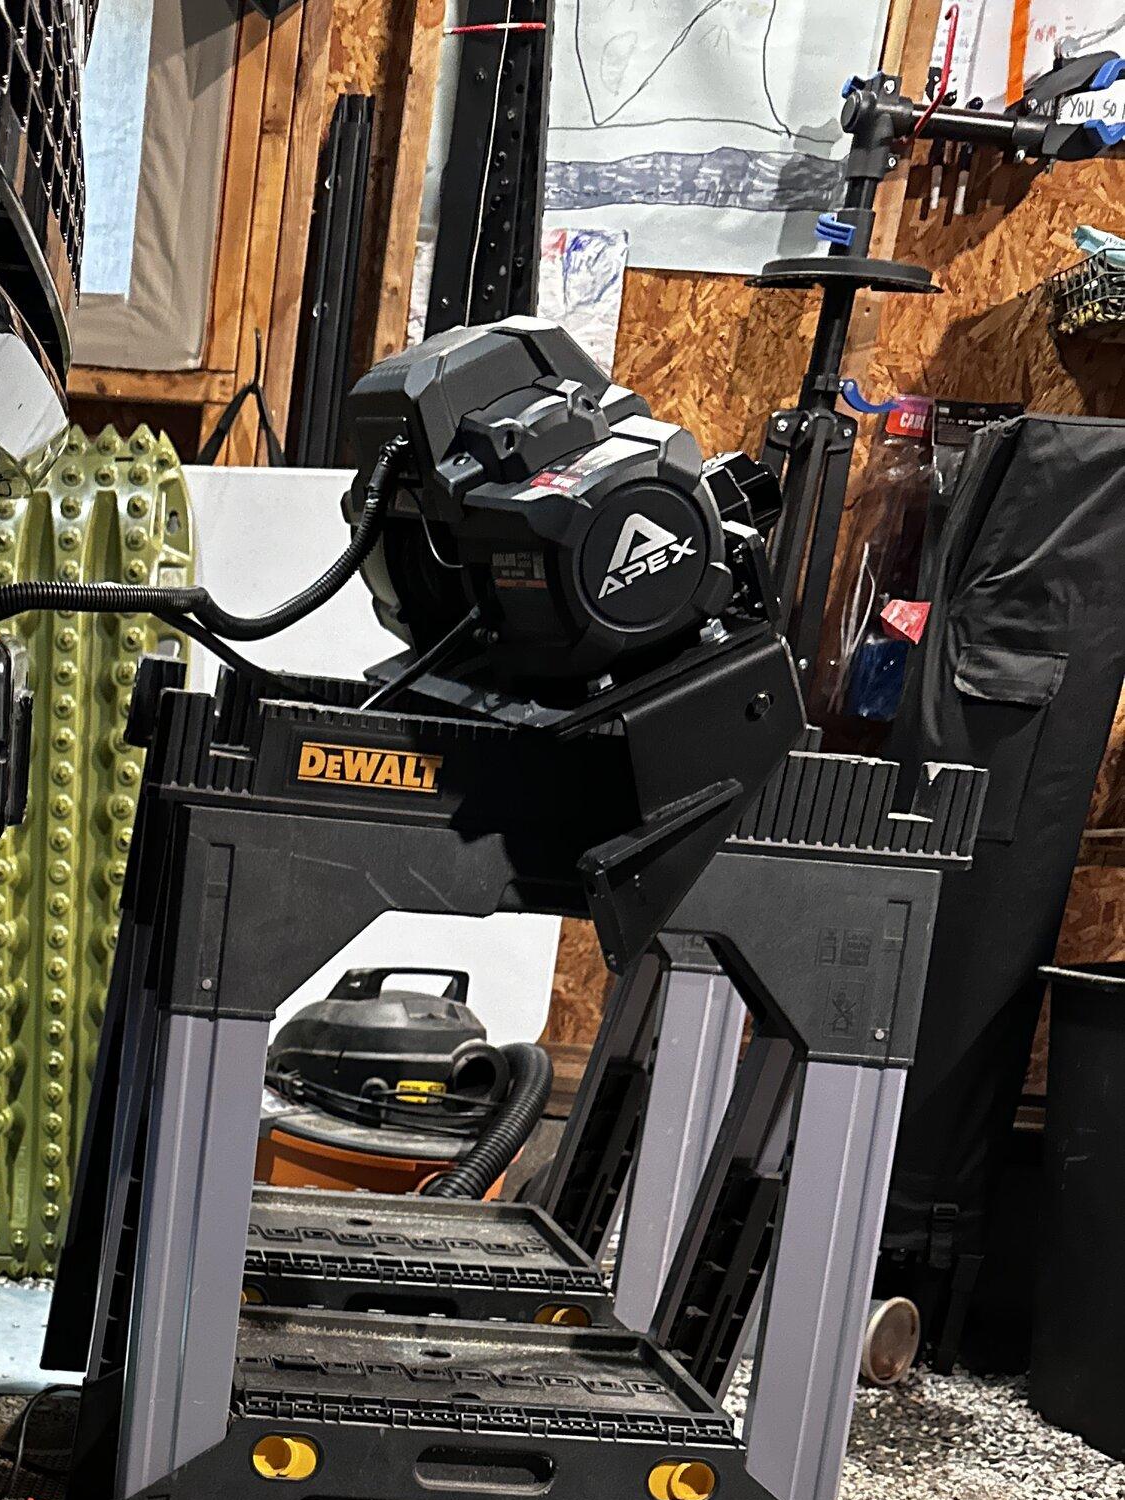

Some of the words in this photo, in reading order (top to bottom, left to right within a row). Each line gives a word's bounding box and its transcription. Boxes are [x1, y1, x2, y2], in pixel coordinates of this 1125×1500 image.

[1069, 96, 1095, 118] YOU
[597, 536, 697, 600] APEX
[298, 746, 443, 789] DEWALT
